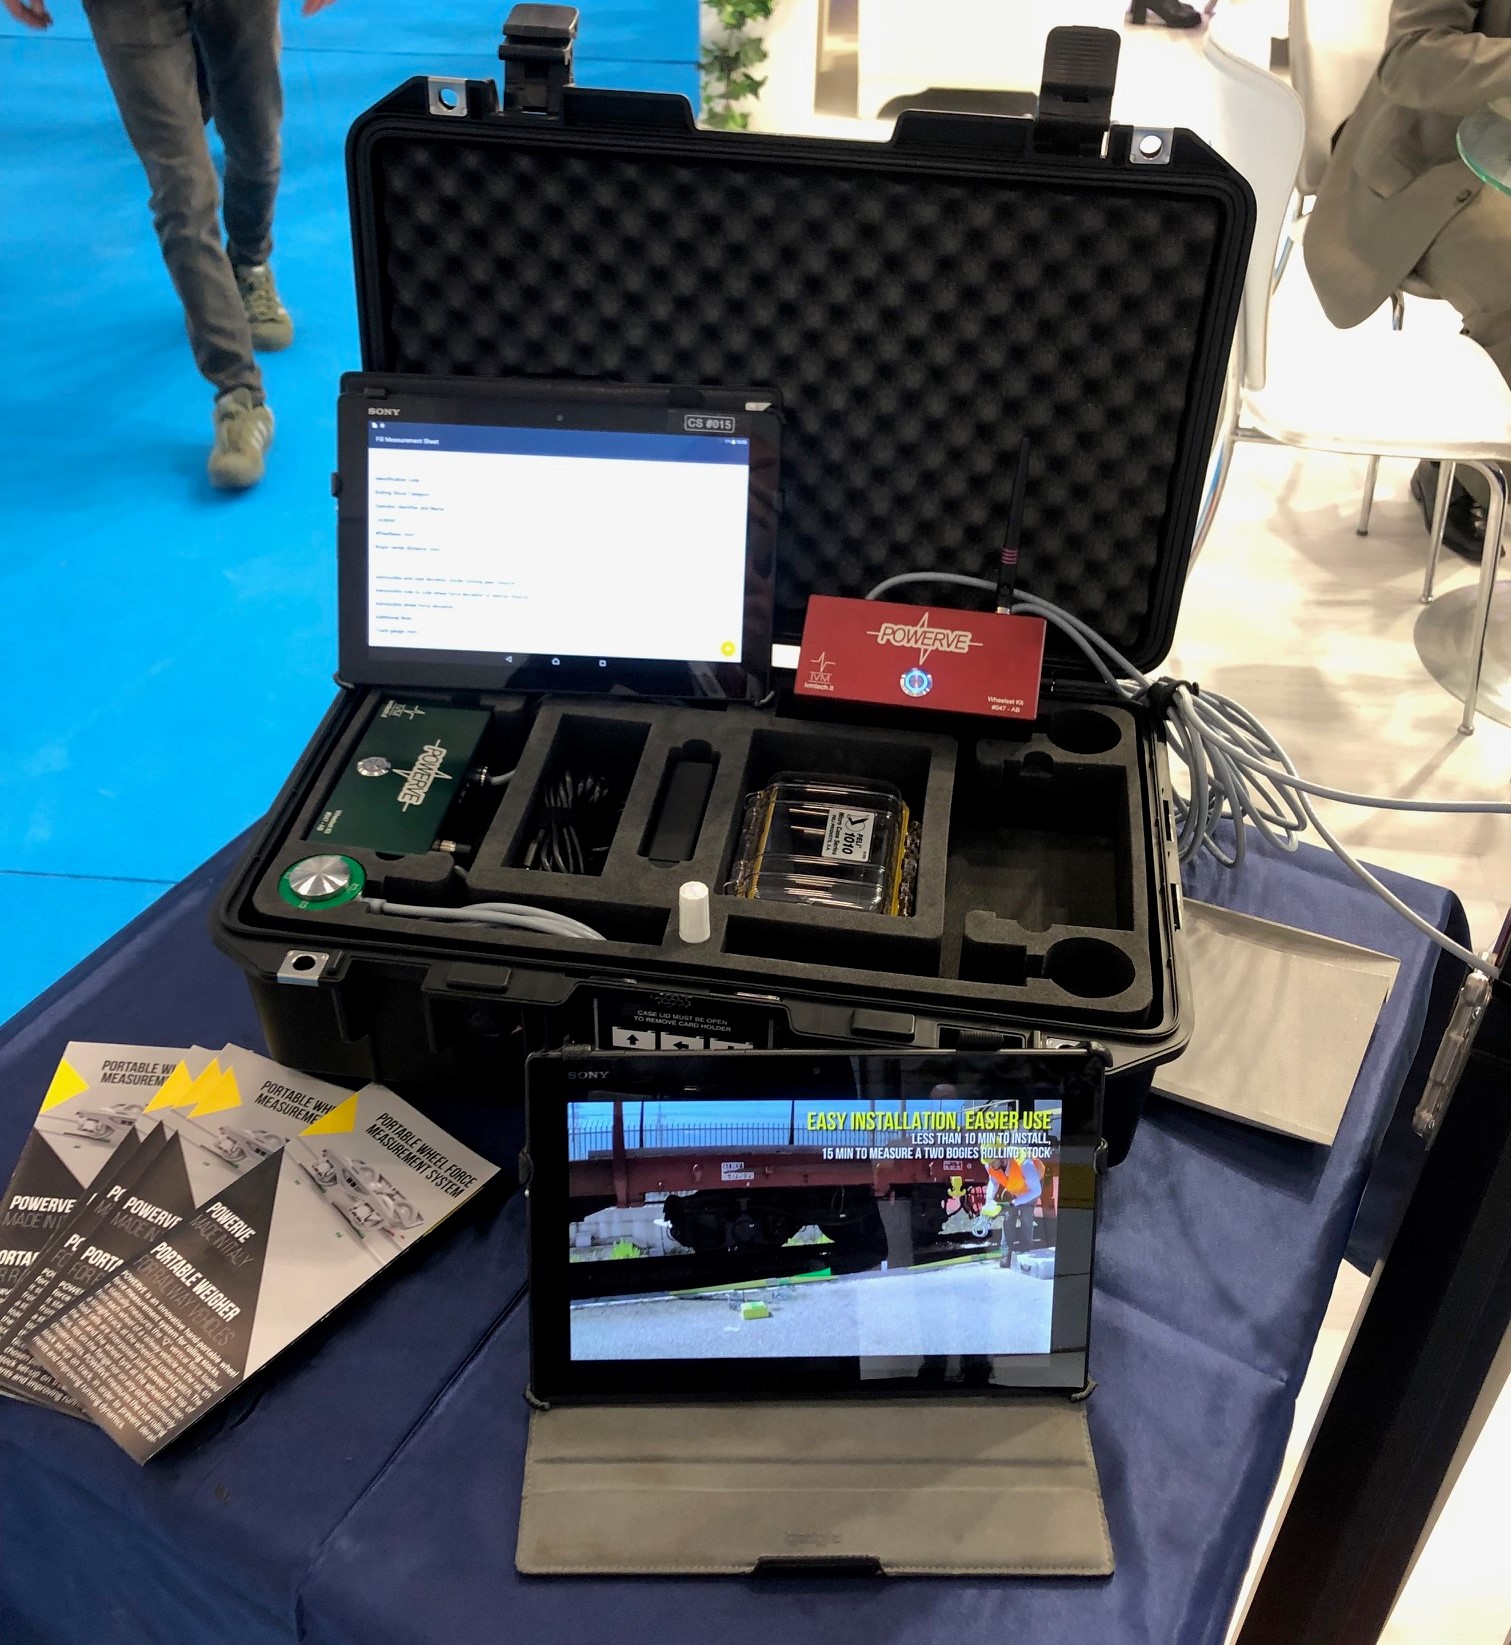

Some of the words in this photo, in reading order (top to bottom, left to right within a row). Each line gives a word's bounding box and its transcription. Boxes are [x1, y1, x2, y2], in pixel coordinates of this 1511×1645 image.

[368, 408, 401, 416] SONY
[688, 418, 703, 428] CS
[706, 419, 732, 429] #015
[879, 625, 970, 651] POWERVE
[810, 672, 831, 682] IVM
[398, 745, 447, 805] POWERVE
[842, 832, 856, 855] 1010
[646, 1017, 677, 1026] REMOVE
[678, 1020, 699, 1029] CARD
[701, 1023, 732, 1032] HOLDER
[672, 1014, 693, 1022] MUST
[706, 1018, 728, 1026] OPEN
[102, 1060, 157, 1074] PORTABLE
[568, 1071, 610, 1080] SONY
[100, 1073, 166, 1087] MEASUREM
[260, 1080, 314, 1108] PORTABLE
[254, 1093, 322, 1125] MEASUREME
[807, 1112, 846, 1131] EASY
[850, 1112, 961, 1132] INSTALLATION,
[966, 1112, 1019, 1131] EASIER
[1024, 1112, 1052, 1131] USE
[375, 1113, 423, 1149] PORTABLE
[416, 1143, 449, 1170] WHEEL
[444, 1164, 478, 1188] FORCE
[912, 1133, 935, 1144] LESS
[936, 1133, 962, 1144] THAN
[964, 1133, 976, 1144] 10
[978, 1133, 996, 1144] MIN
[998, 1133, 1010, 1144] TO
[1012, 1132, 1051, 1145] INSTALL,
[365, 1124, 432, 1175] MEASUREMENT
[425, 1170, 465, 1199] SYSTEM
[822, 1147, 834, 1160] 15
[835, 1147, 854, 1160] MIN
[855, 1147, 868, 1160] TO
[869, 1147, 914, 1160] MEASURE
[915, 1147, 922, 1160] A
[924, 1147, 944, 1160] TWO
[946, 1147, 979, 1160] BOGIES
[981, 1147, 1020, 1160] ROLLING
[1021, 1147, 1051, 1160] STOCK
[10, 1196, 78, 1214] POWERVE
[2, 1212, 41, 1228] MADE
[110, 1211, 146, 1238] MADE
[189, 1214, 218, 1242] MADE
[206, 1202, 257, 1244] POWERVE
[80, 1246, 125, 1273] PORT
[150, 1241, 203, 1287] PORTABLE
[192, 1278, 242, 1323] WEIGHER
[119, 1269, 148, 1294] POWERVE
[156, 1303, 187, 1331] innovative
[123, 1287, 162, 1322] measurement
[82, 1352, 111, 1379] POWERVE
